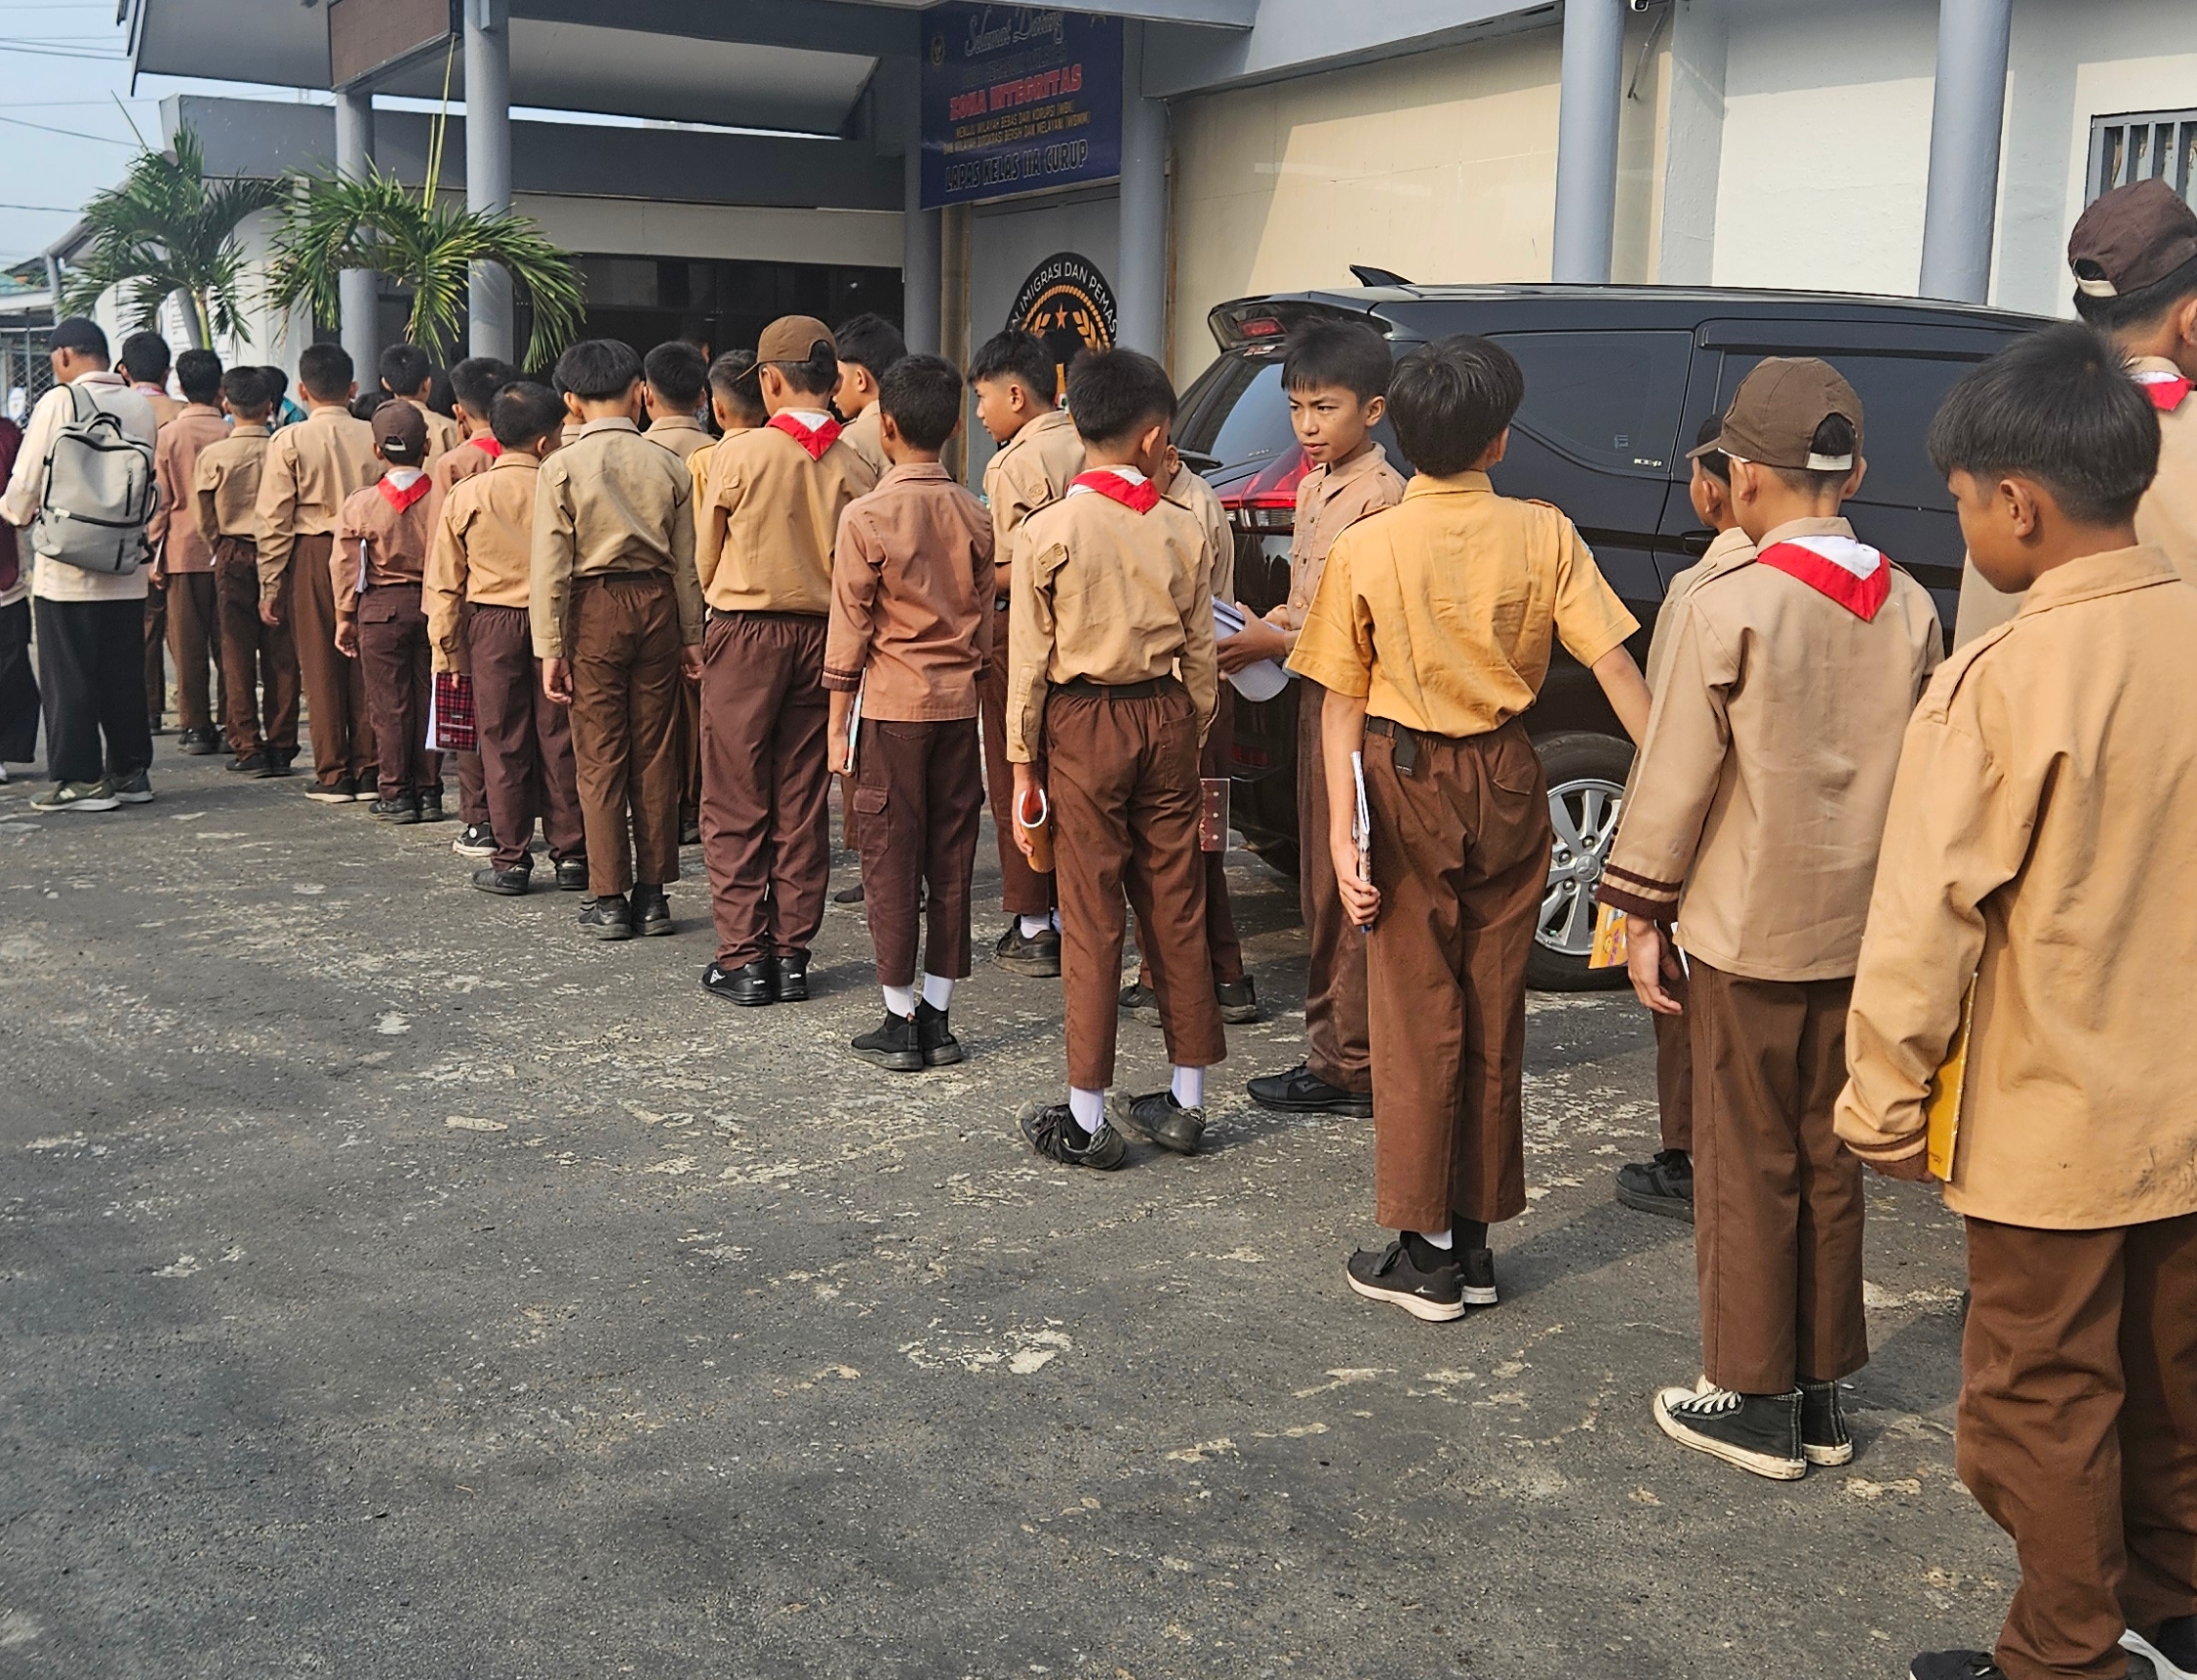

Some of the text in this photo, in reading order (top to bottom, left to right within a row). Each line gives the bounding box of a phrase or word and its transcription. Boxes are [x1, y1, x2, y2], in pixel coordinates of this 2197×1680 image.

[989, 63, 1082, 111] INTEGRITAS
[945, 139, 1089, 192] LAPAS KELAS IIA CURUP
[1019, 261, 1118, 341] IMIGRASI DAN PEMAS
